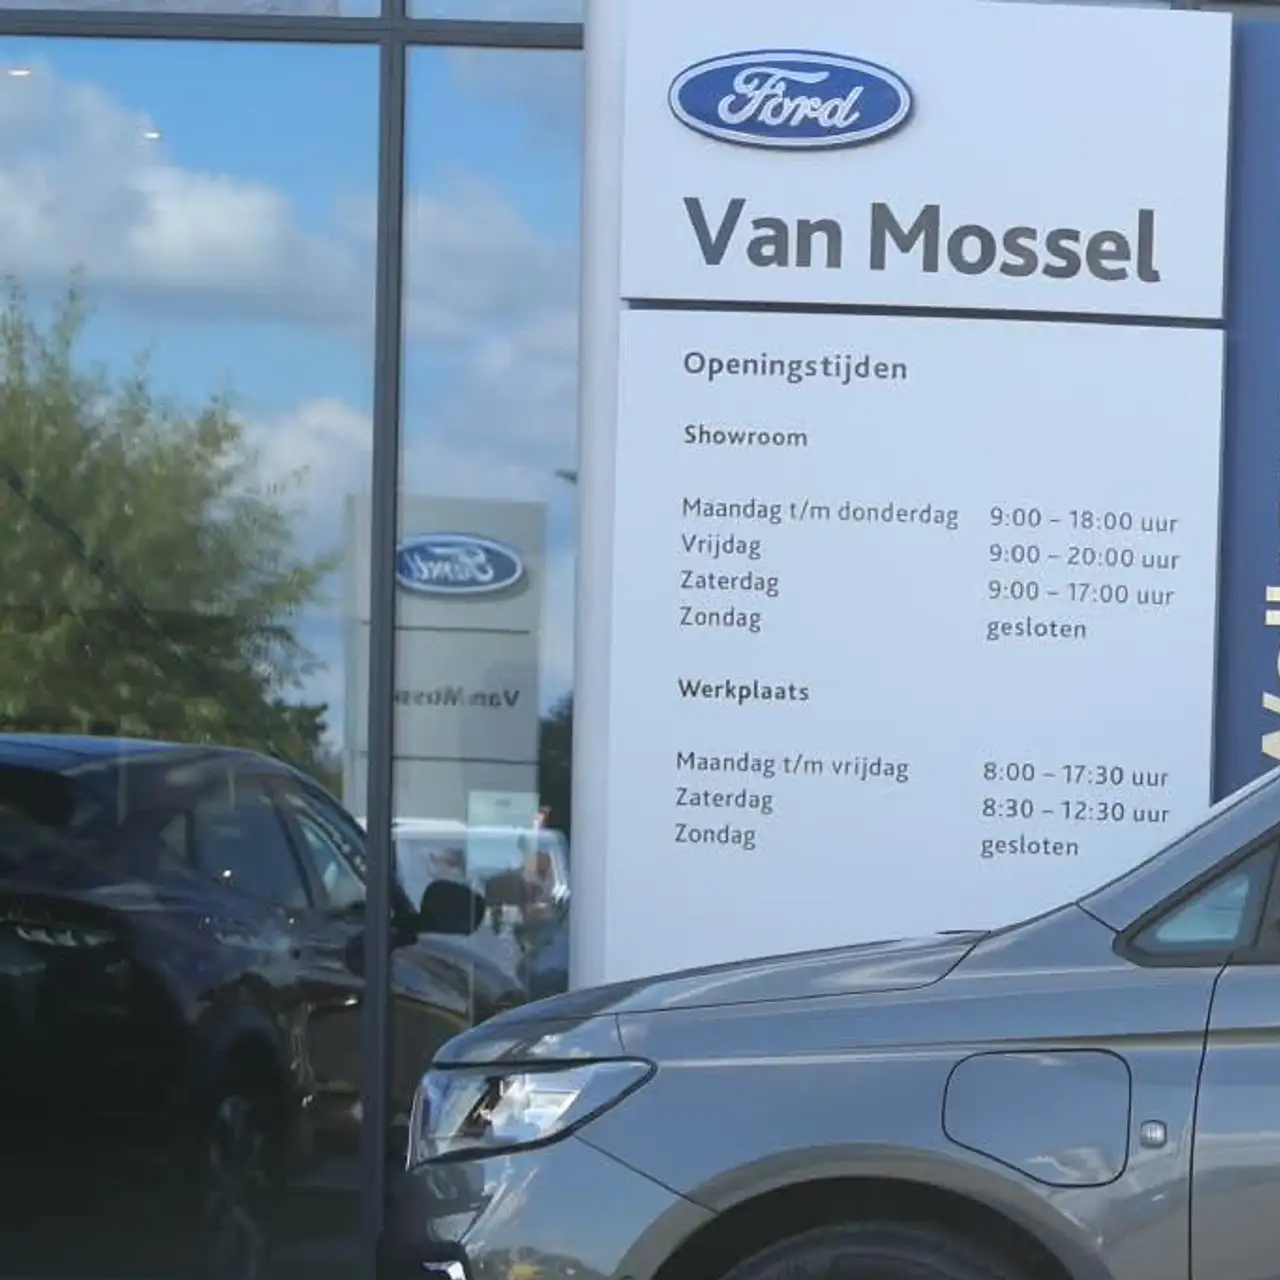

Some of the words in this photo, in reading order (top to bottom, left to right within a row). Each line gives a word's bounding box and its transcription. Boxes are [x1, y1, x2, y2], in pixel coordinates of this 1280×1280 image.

[718, 66, 864, 130] Ford
[683, 197, 842, 269] Van
[870, 202, 1161, 283] Mossel
[683, 351, 907, 385] Openingstijden
[683, 423, 808, 448] Showroom
[682, 496, 782, 525] Maandag
[789, 498, 831, 523] t/m
[837, 501, 959, 531] donderdag
[989, 506, 1042, 529] 9:00
[1069, 510, 1133, 532] 18:00
[1141, 514, 1180, 534] uur
[681, 533, 762, 561] Vrijdag
[989, 542, 1041, 565] 9:00
[1067, 545, 1135, 568] 20:00
[1142, 551, 1181, 570] uur
[680, 569, 779, 598] Zaterdag
[987, 579, 1040, 602] 9:00
[1067, 583, 1129, 605] 17:00
[1136, 586, 1176, 606] uur
[679, 605, 762, 634] Zondag
[986, 617, 1087, 641] gesloten
[678, 679, 810, 705] Werkplaats
[676, 751, 775, 779] Maandag
[782, 753, 825, 776] t/m
[831, 756, 910, 783] vrijdag
[983, 761, 1036, 784] 8:00
[1062, 765, 1124, 788] 17:30
[1131, 768, 1170, 788] uur
[676, 786, 774, 815] Zaterdag
[982, 797, 1035, 820] 8:30
[1060, 801, 1125, 824] 12:30
[1132, 804, 1171, 824] uur
[675, 823, 757, 852] Zondag
[981, 834, 1080, 860] gesloten
